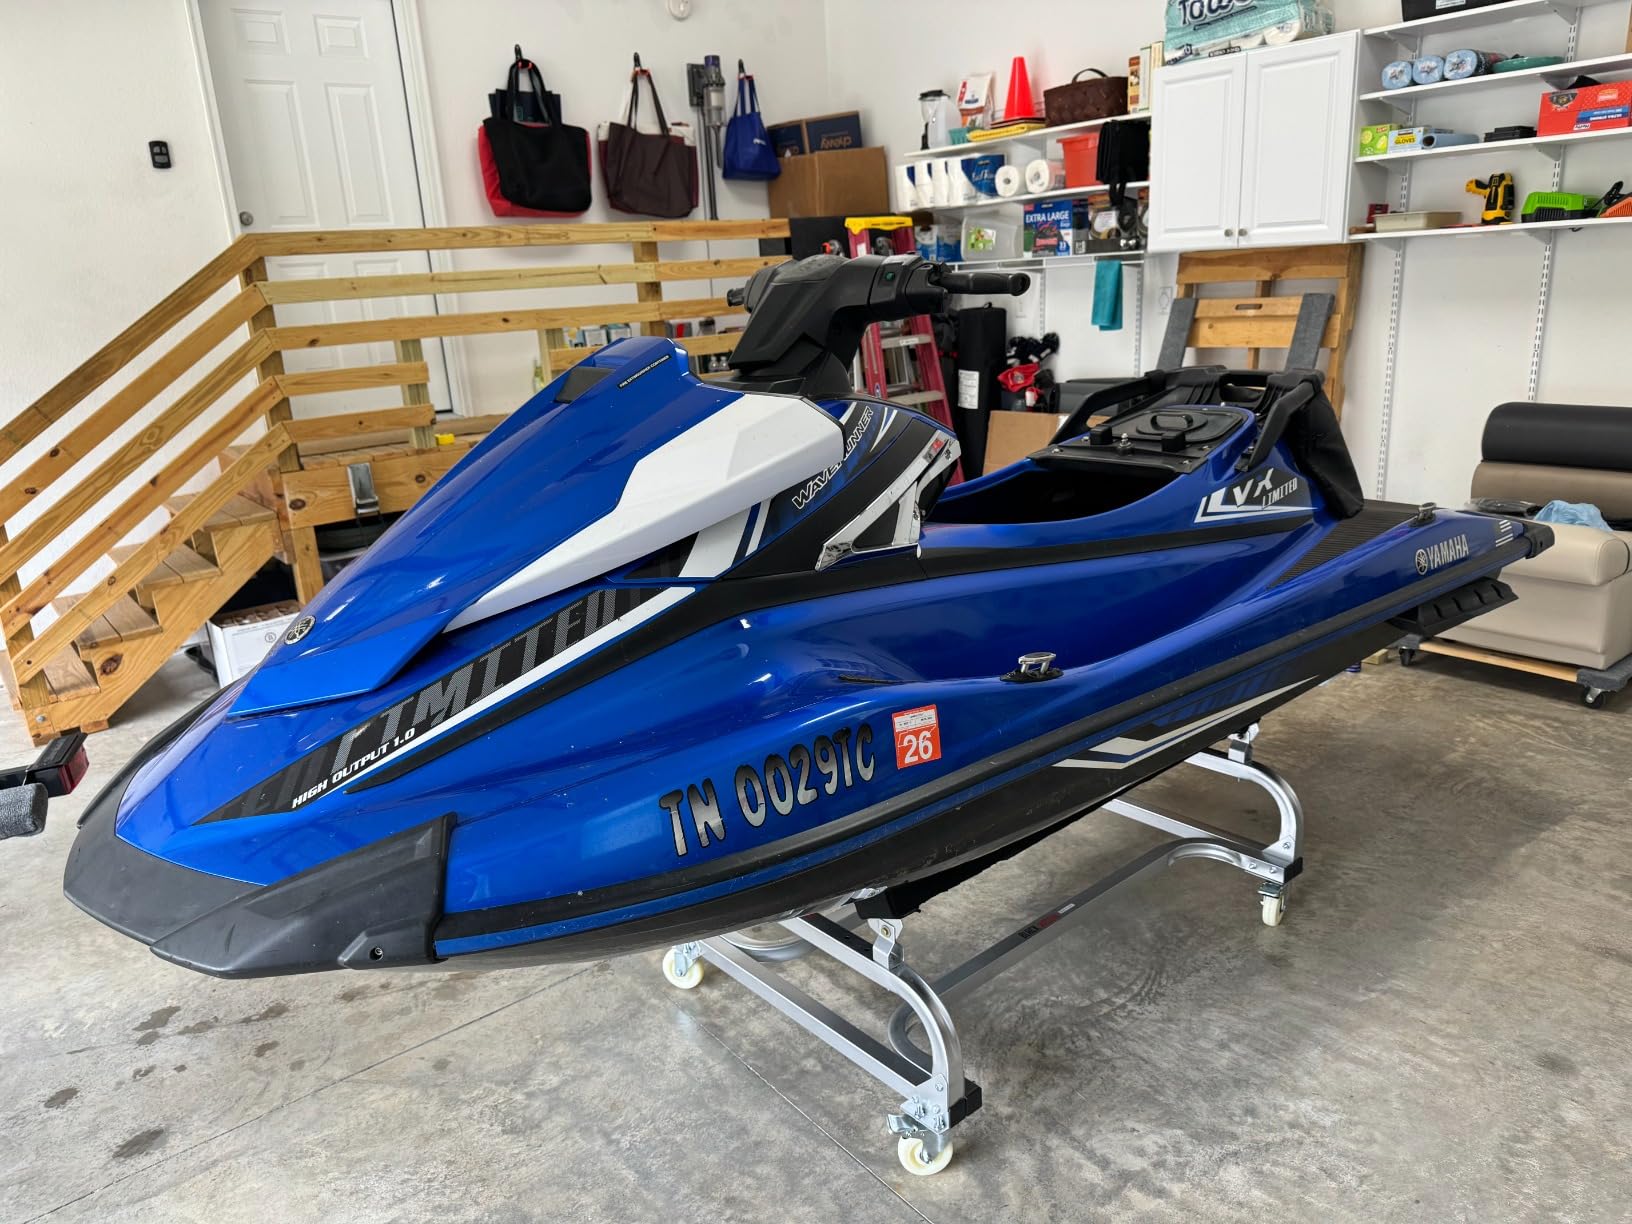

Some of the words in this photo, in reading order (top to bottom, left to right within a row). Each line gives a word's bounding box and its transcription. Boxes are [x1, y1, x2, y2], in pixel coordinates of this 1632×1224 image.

[1179, 0, 1252, 24] Tow
[1025, 213, 1046, 223] EXTRA
[1047, 210, 1069, 221] LARGE
[1232, 467, 1274, 506] VX
[1262, 477, 1298, 510] LIMITED
[1426, 533, 1470, 570] YAMAHA
[903, 730, 933, 764] 26
[292, 779, 329, 809] HIGH
[331, 742, 390, 784] OUTPUT
[393, 727, 416, 748] 1.0
[658, 778, 727, 857] TN
[733, 722, 876, 828] 0029TC
